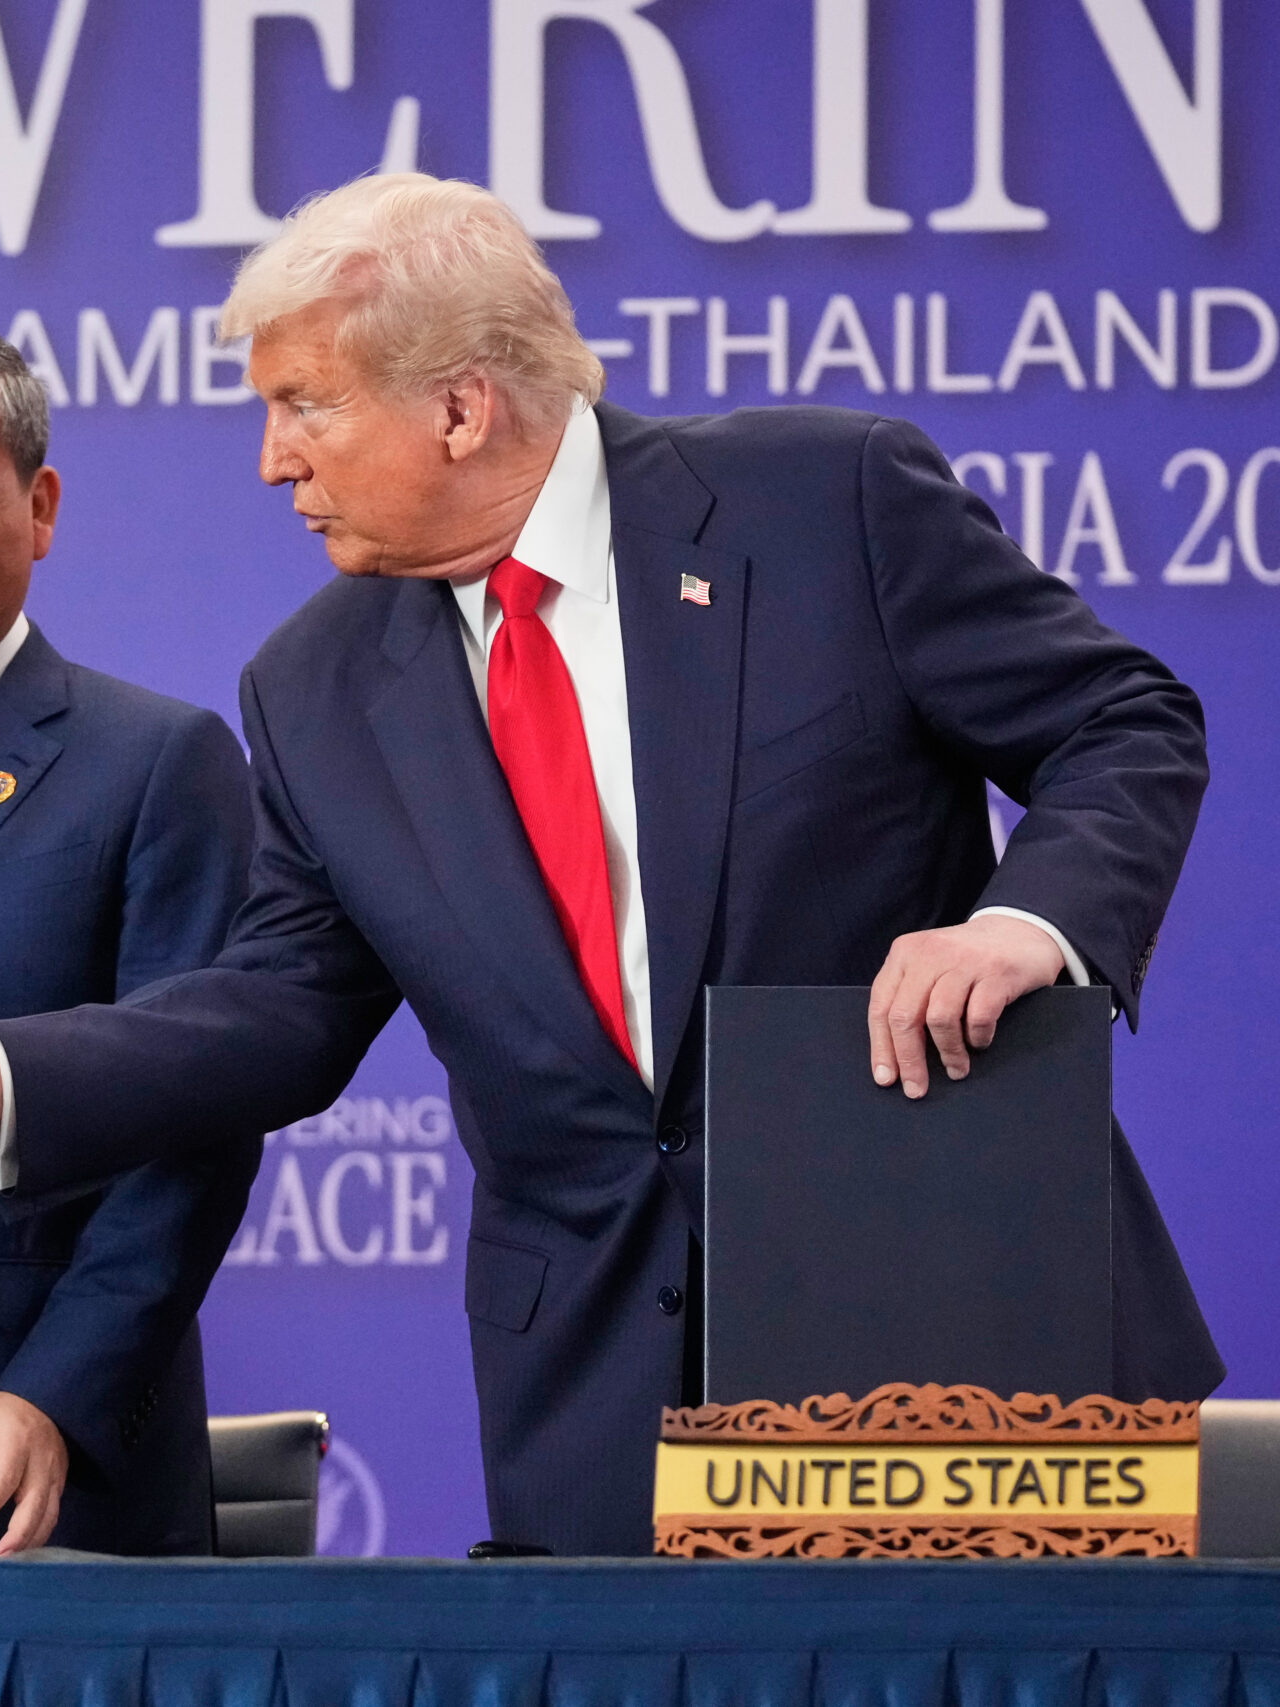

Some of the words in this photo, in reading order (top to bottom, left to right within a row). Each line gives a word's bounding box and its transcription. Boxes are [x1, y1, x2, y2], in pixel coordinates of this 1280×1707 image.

[220, 1150, 452, 1268] ACE
[705, 1457, 926, 1508] UNITED
[943, 1456, 1147, 1506] STATES
